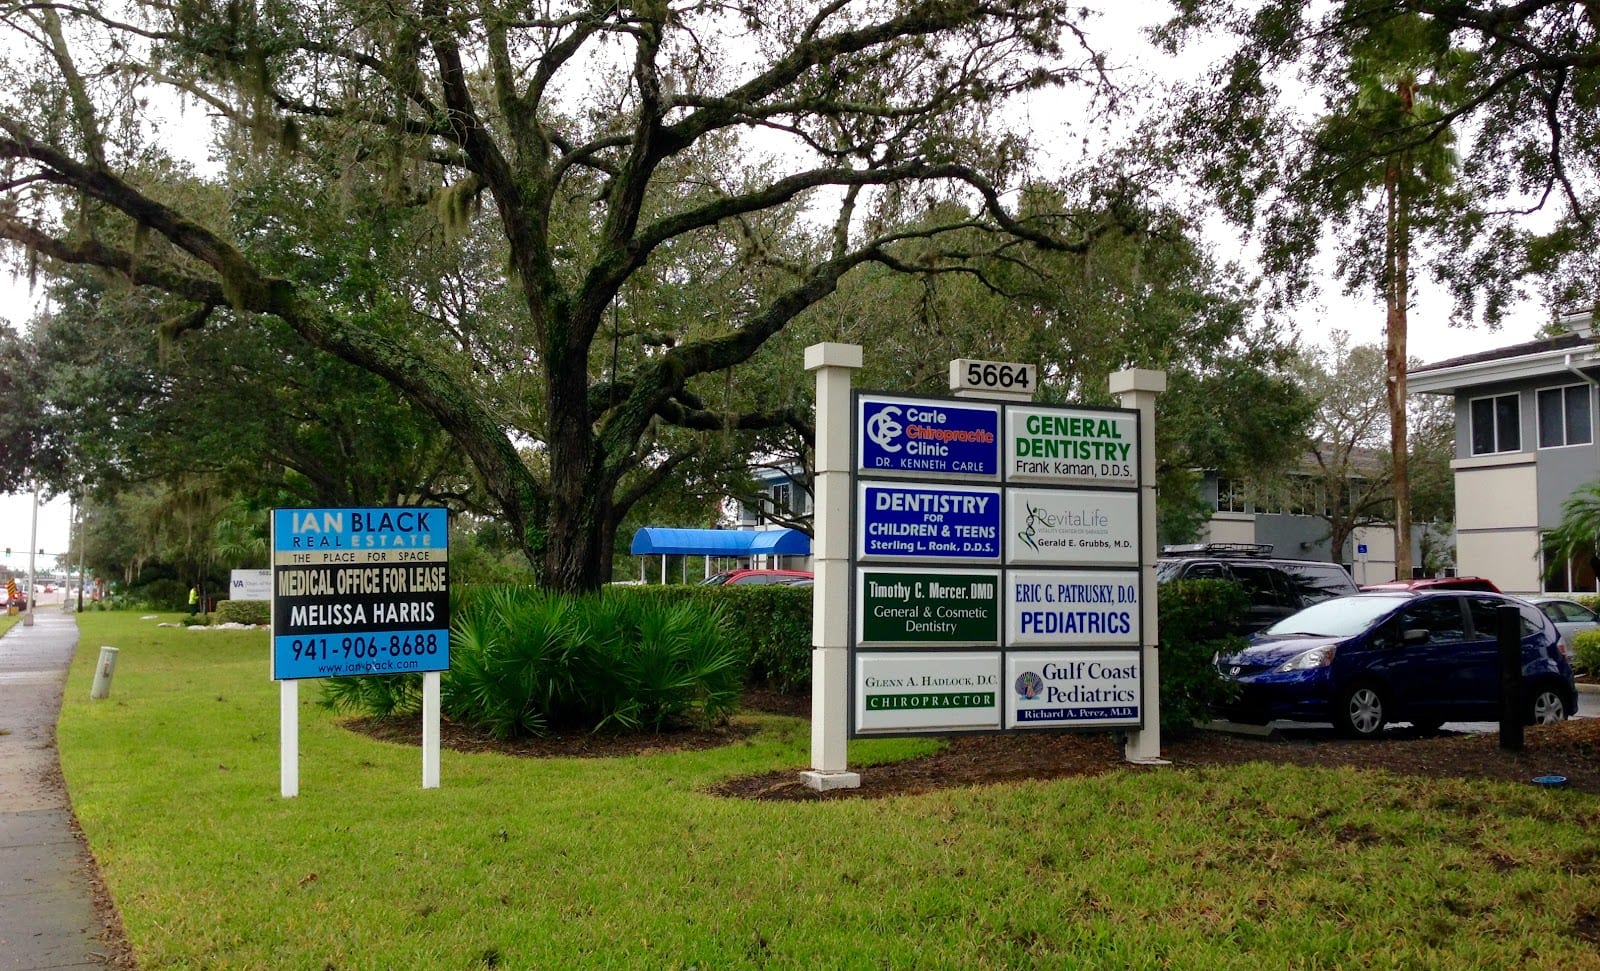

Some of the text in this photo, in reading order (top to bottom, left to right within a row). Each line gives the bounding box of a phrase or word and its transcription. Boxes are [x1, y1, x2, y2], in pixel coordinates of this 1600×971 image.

[967, 363, 1029, 388] 5664
[906, 408, 947, 424] Carle
[906, 424, 993, 443] Chiropractic
[1026, 415, 1122, 439] GENERAL
[906, 441, 949, 456] Clinic
[1016, 437, 1131, 462] DENTISTRY
[875, 456, 984, 472] DR. KENNETH CARLE
[1016, 460, 1133, 477] Frank Kaman, D.D.S.
[875, 492, 989, 514] DENTISTRY
[292, 512, 430, 534] IAN BLACK
[923, 514, 944, 523] FOR
[1037, 508, 1109, 528] RevitaLife
[869, 522, 996, 539] CHILDREN & TEENS
[292, 534, 431, 548] REAL ESTATE
[870, 540, 994, 553] Sterling L. Ronk, D.D.S.
[1037, 538, 1132, 549] Gerald E. Grubbs, M.D.
[293, 551, 430, 563] THE PLACE FOR SPACE
[233, 580, 244, 588] VA
[278, 567, 447, 597] MEDICAL OFFICE FOR LEASE
[869, 581, 911, 602] Timothy
[914, 582, 925, 599] C.
[970, 583, 994, 599] DMD
[1015, 584, 1138, 606] ERIC G. PATRUSKY, D.O.
[290, 601, 435, 627] MELISSA HARRIS
[874, 605, 988, 618] General & Cosmetic
[905, 620, 957, 635] Dentistry
[1021, 611, 1131, 634] PEDIATRICS
[292, 633, 438, 662] 941-906-8688
[1042, 662, 1138, 680] Gulf Coast
[865, 674, 998, 688] GLENN A. HADLOCK, D.C.
[870, 694, 991, 708] CHIROPRACTOR
[1046, 684, 1136, 703] Pediatrics
[1024, 709, 1064, 719] Richard
[1066, 709, 1077, 718] A.
[1110, 707, 1133, 717] M.D.
